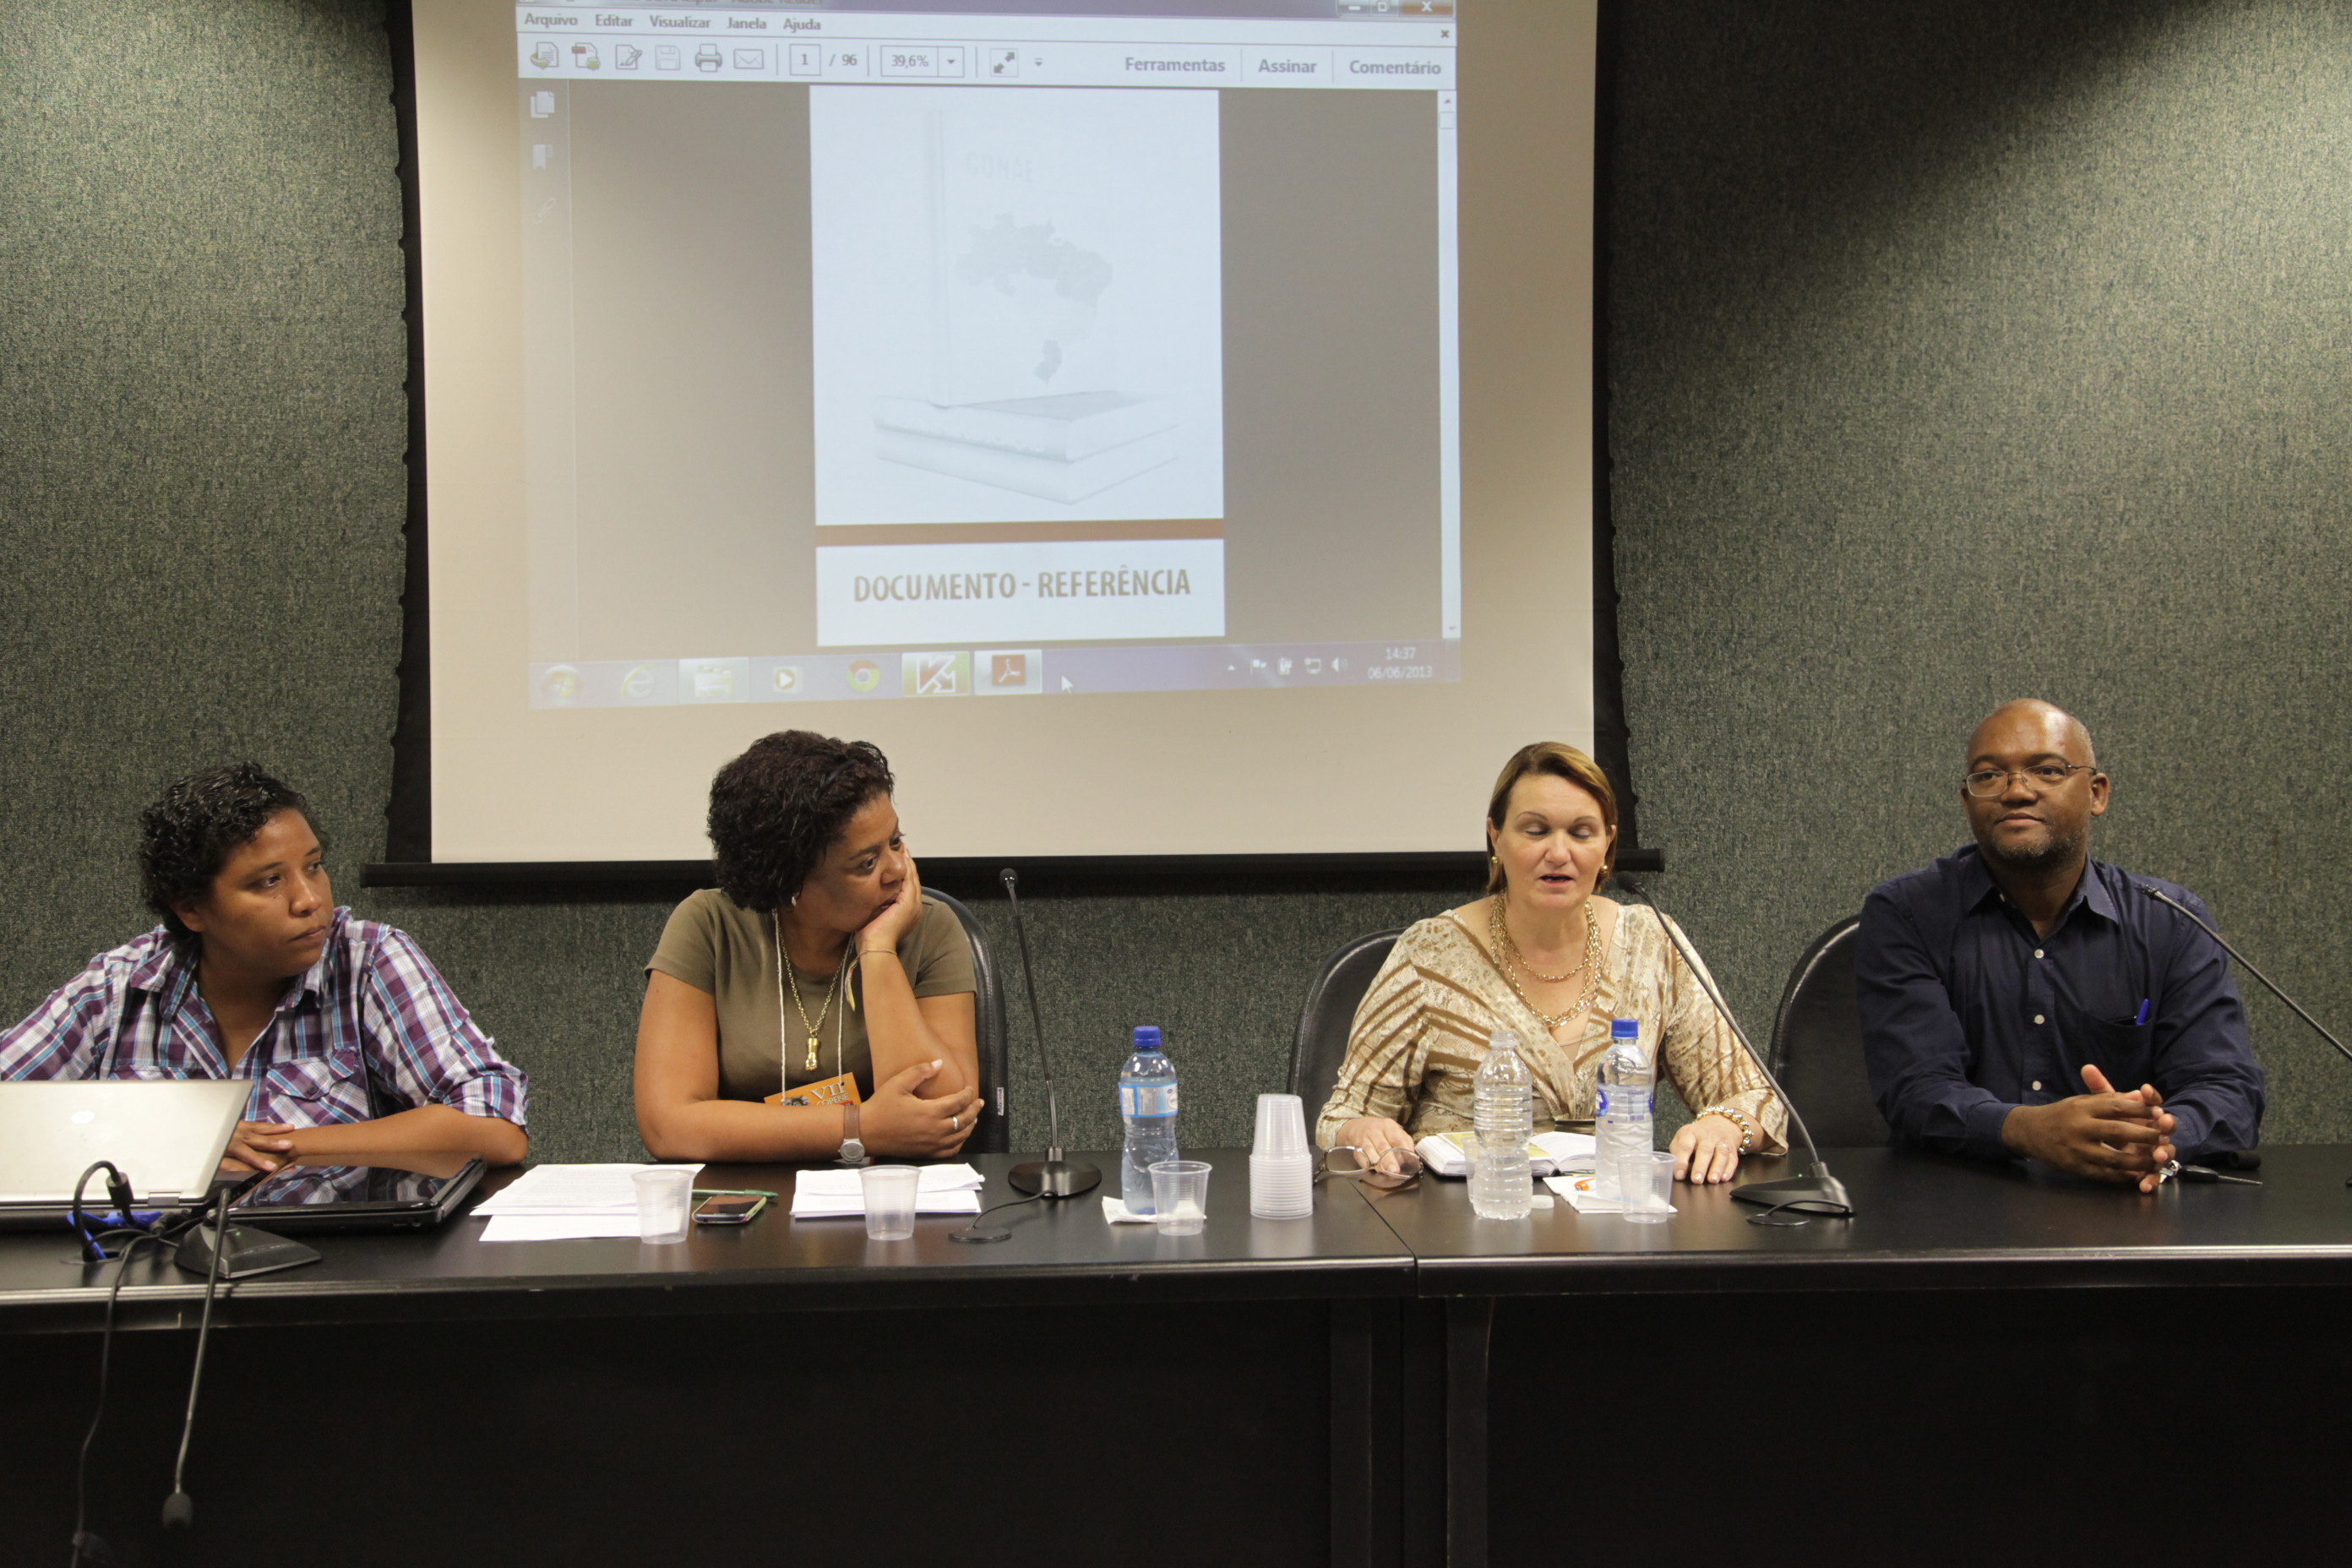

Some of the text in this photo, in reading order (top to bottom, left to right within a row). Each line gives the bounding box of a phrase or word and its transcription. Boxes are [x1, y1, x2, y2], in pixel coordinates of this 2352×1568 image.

[524, 13, 821, 32] Arquivo Editar Visualizar Janela Ajuda
[801, 53, 808, 66] 1
[842, 54, 858, 67] 96
[891, 54, 928, 68] 39,6%
[1124, 57, 1226, 73] Ferramentas
[1259, 58, 1317, 74] Assinar
[1349, 60, 1441, 76] Comentário
[854, 573, 1015, 602] DOCUMENTO
[1038, 564, 1191, 597] REFERÊNCIA
[1386, 647, 1416, 660] 14:37
[1368, 666, 1433, 679] 06/06/2013
[810, 1082, 846, 1099] VII
